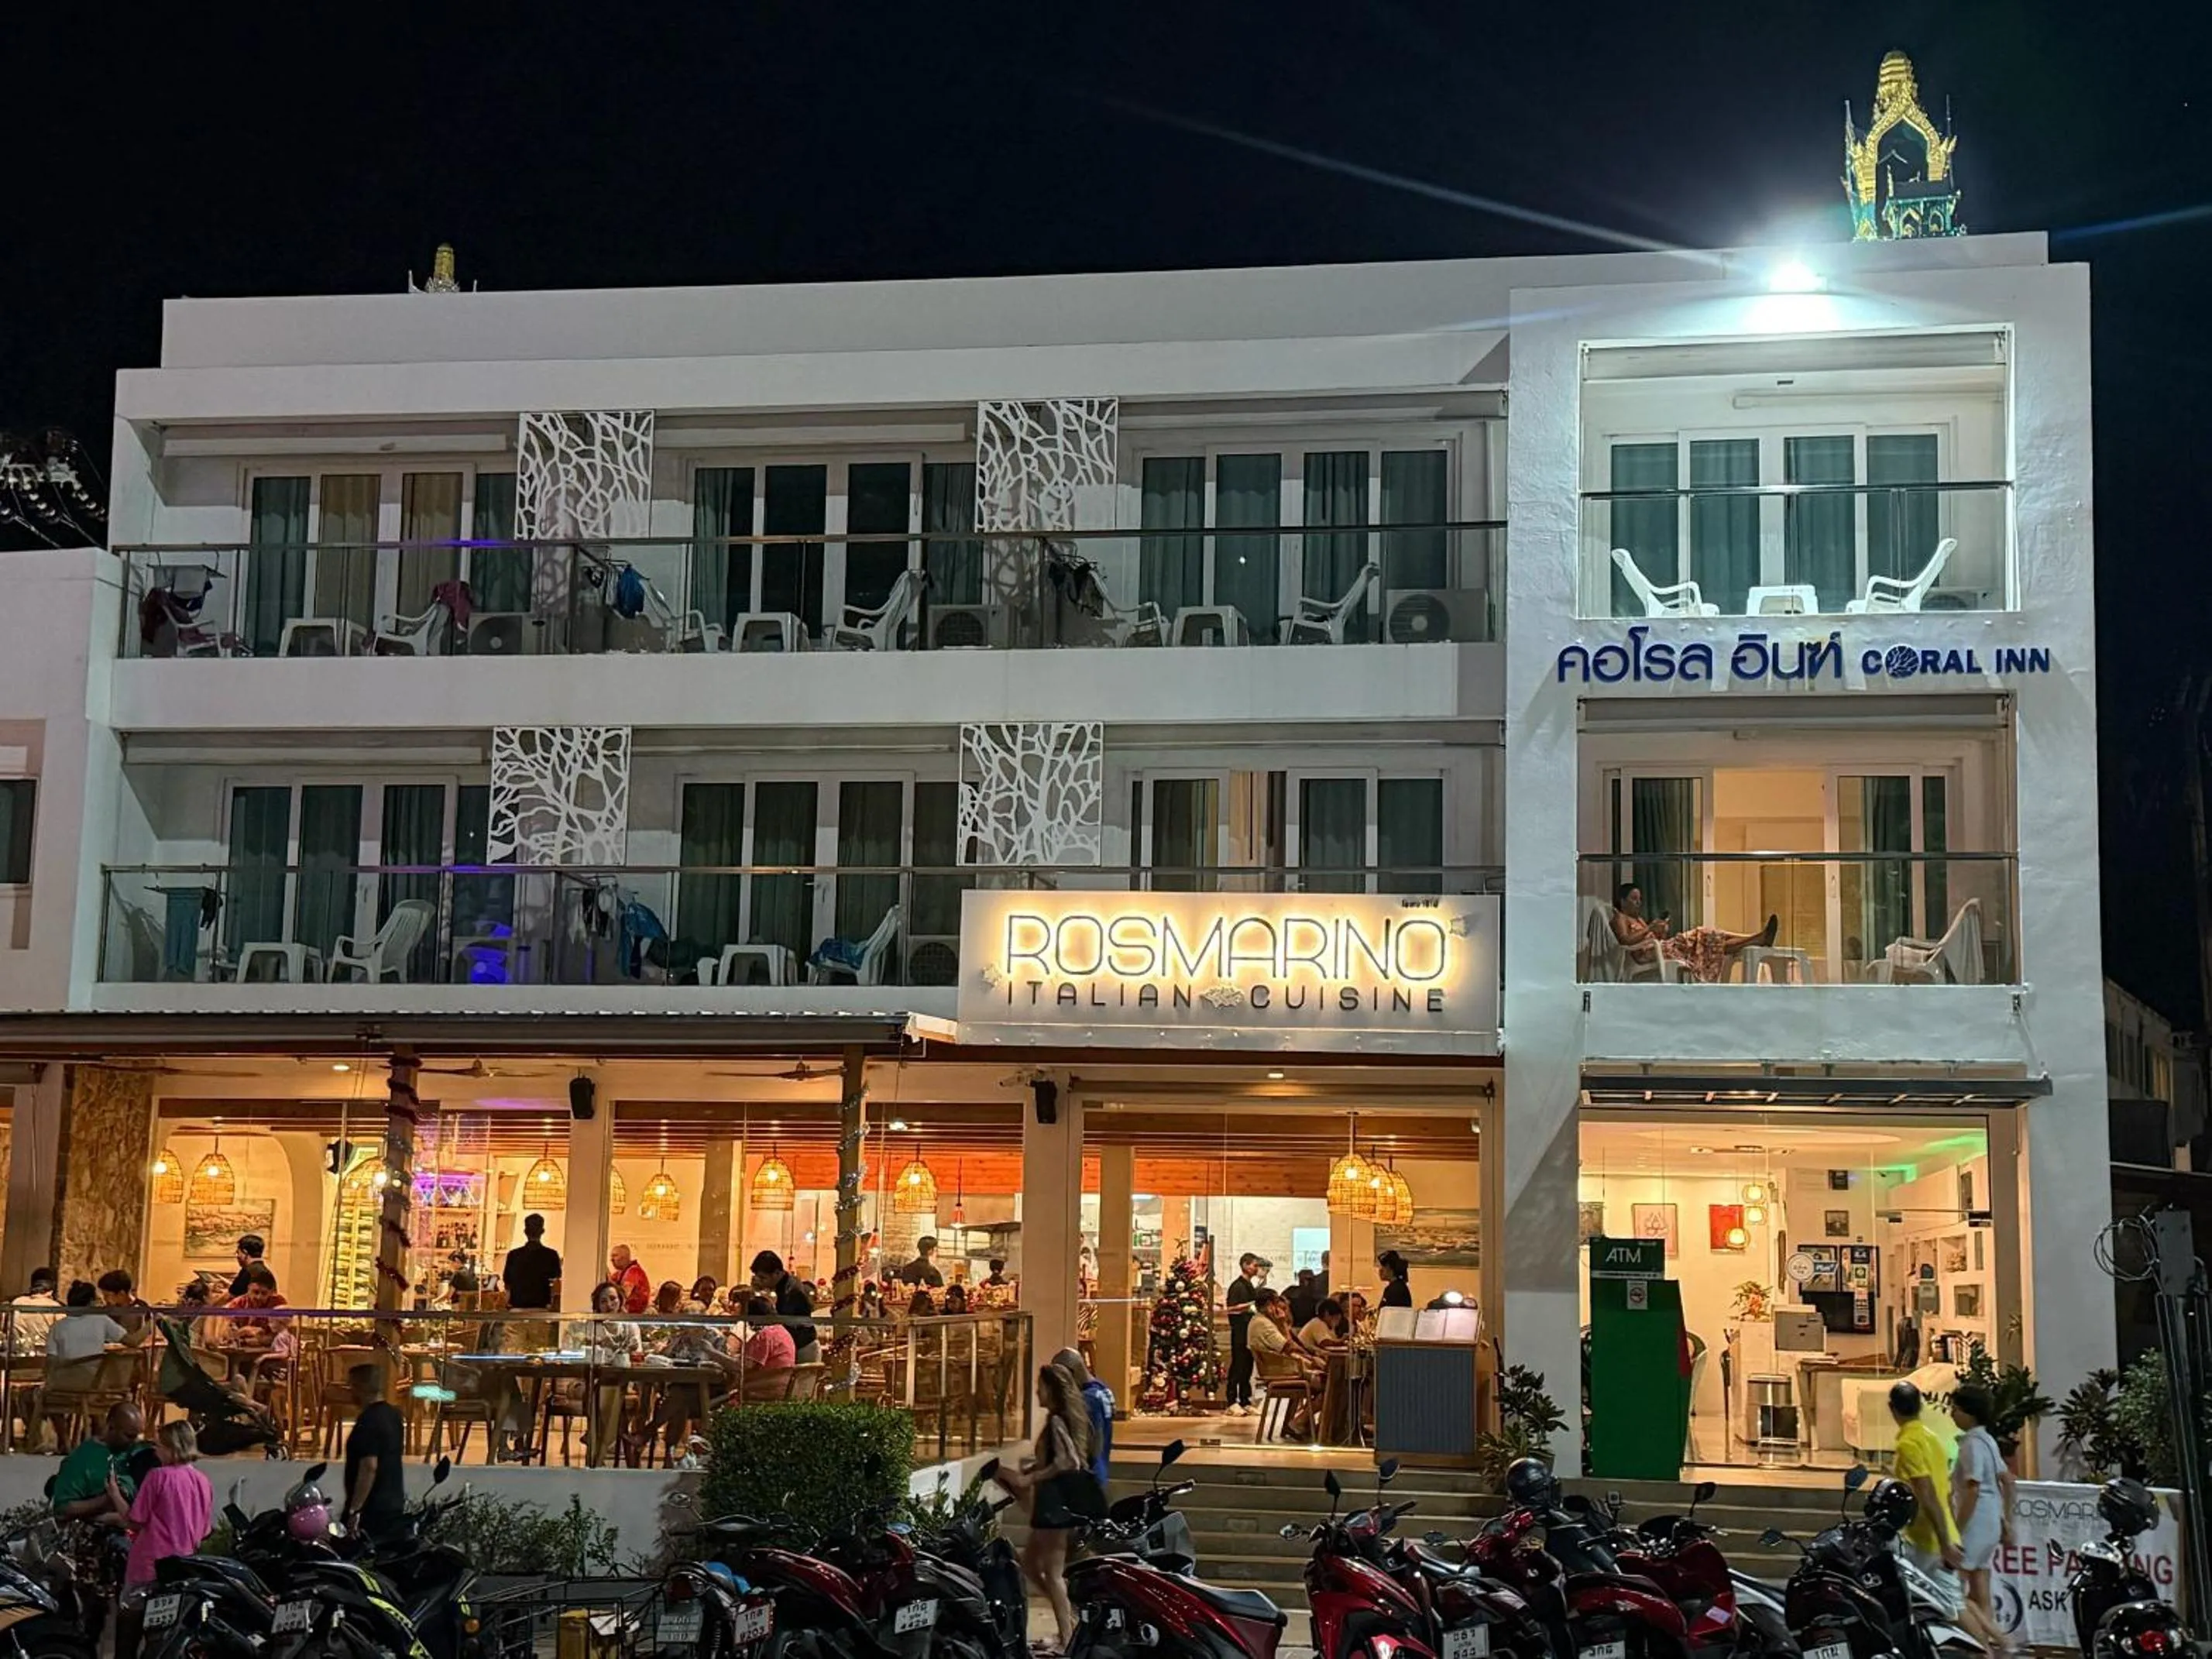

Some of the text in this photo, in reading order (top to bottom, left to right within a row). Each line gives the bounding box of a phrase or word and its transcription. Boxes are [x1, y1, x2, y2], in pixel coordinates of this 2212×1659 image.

[1558, 626, 1713, 682] คอโรล
[1861, 645, 2050, 678] CORAL INN
[1007, 915, 1446, 981] ROSMARINO
[1008, 981, 1444, 1012] ITALIAN CUISINE
[1605, 1246, 1642, 1263] ATM
[2014, 1499, 2100, 1520] OSMAR
[2028, 1590, 2067, 1611] ASK
